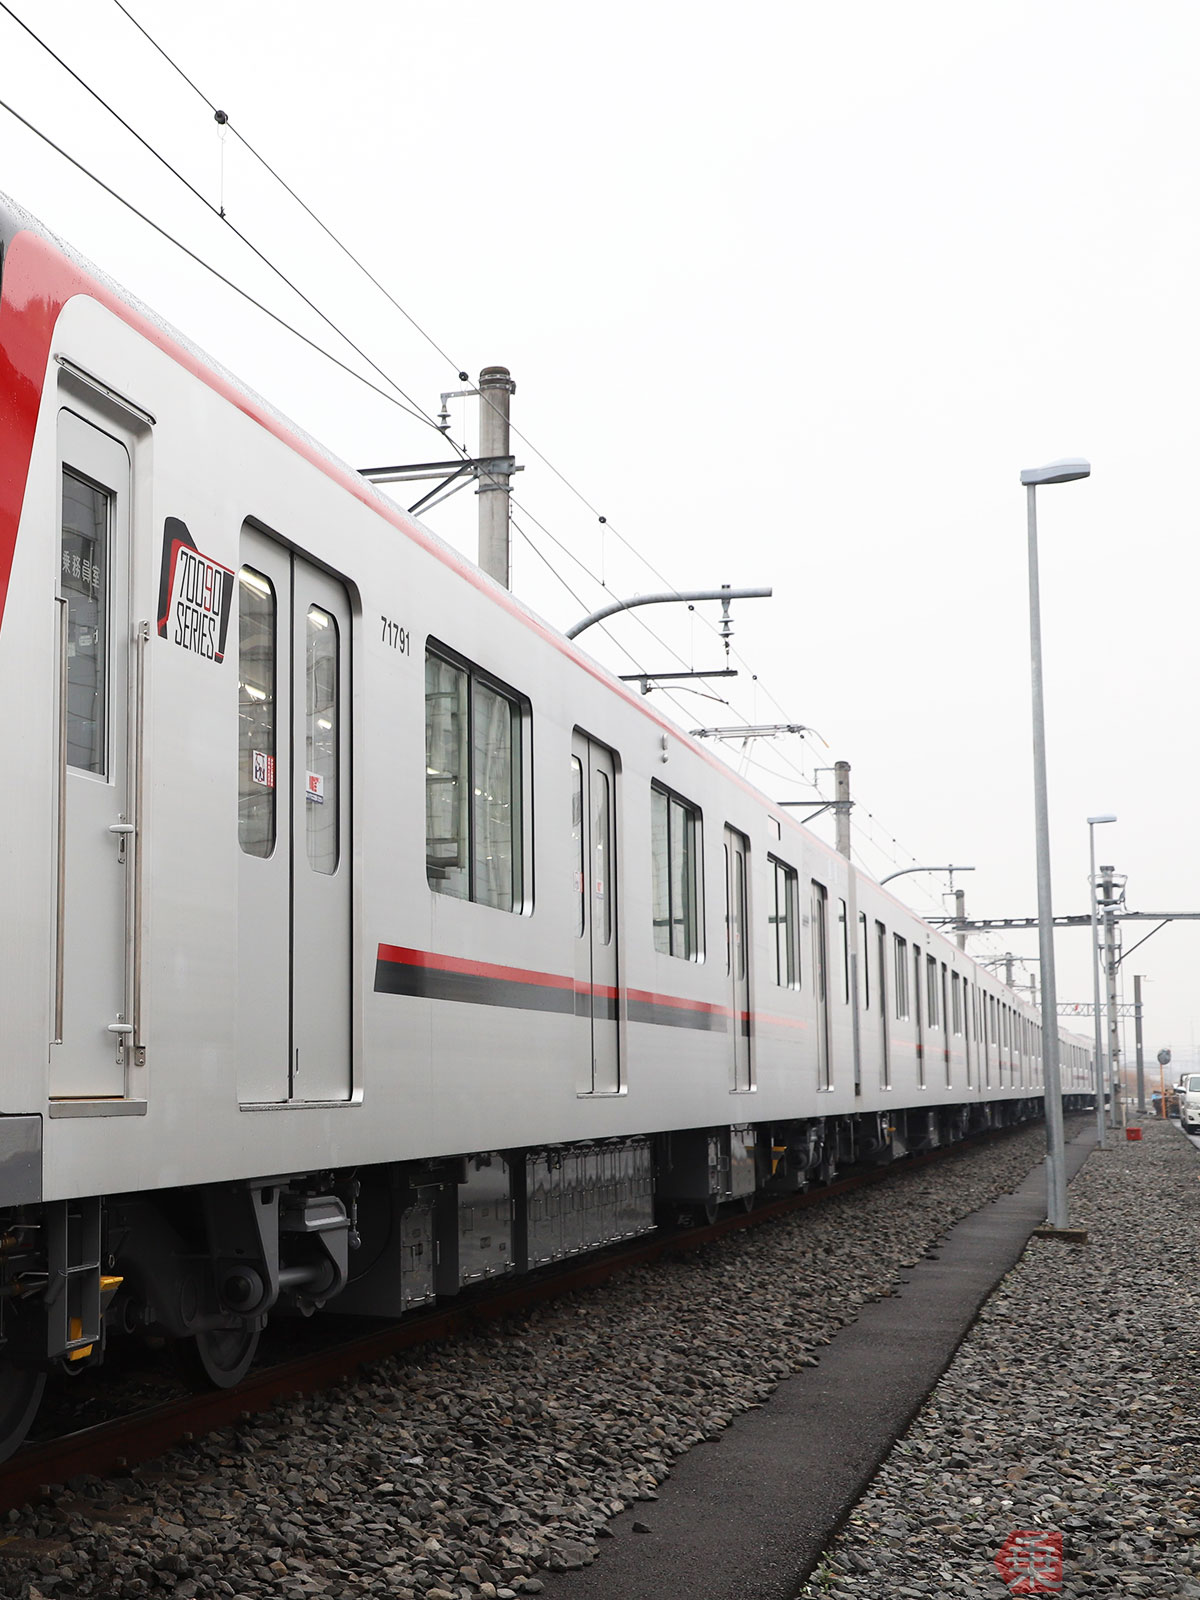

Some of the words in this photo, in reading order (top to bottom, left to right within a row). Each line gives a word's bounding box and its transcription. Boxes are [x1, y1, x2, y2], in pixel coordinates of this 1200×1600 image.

[180, 551, 222, 617] 70090
[174, 602, 217, 661] SERIES
[381, 616, 412, 657] 71791
